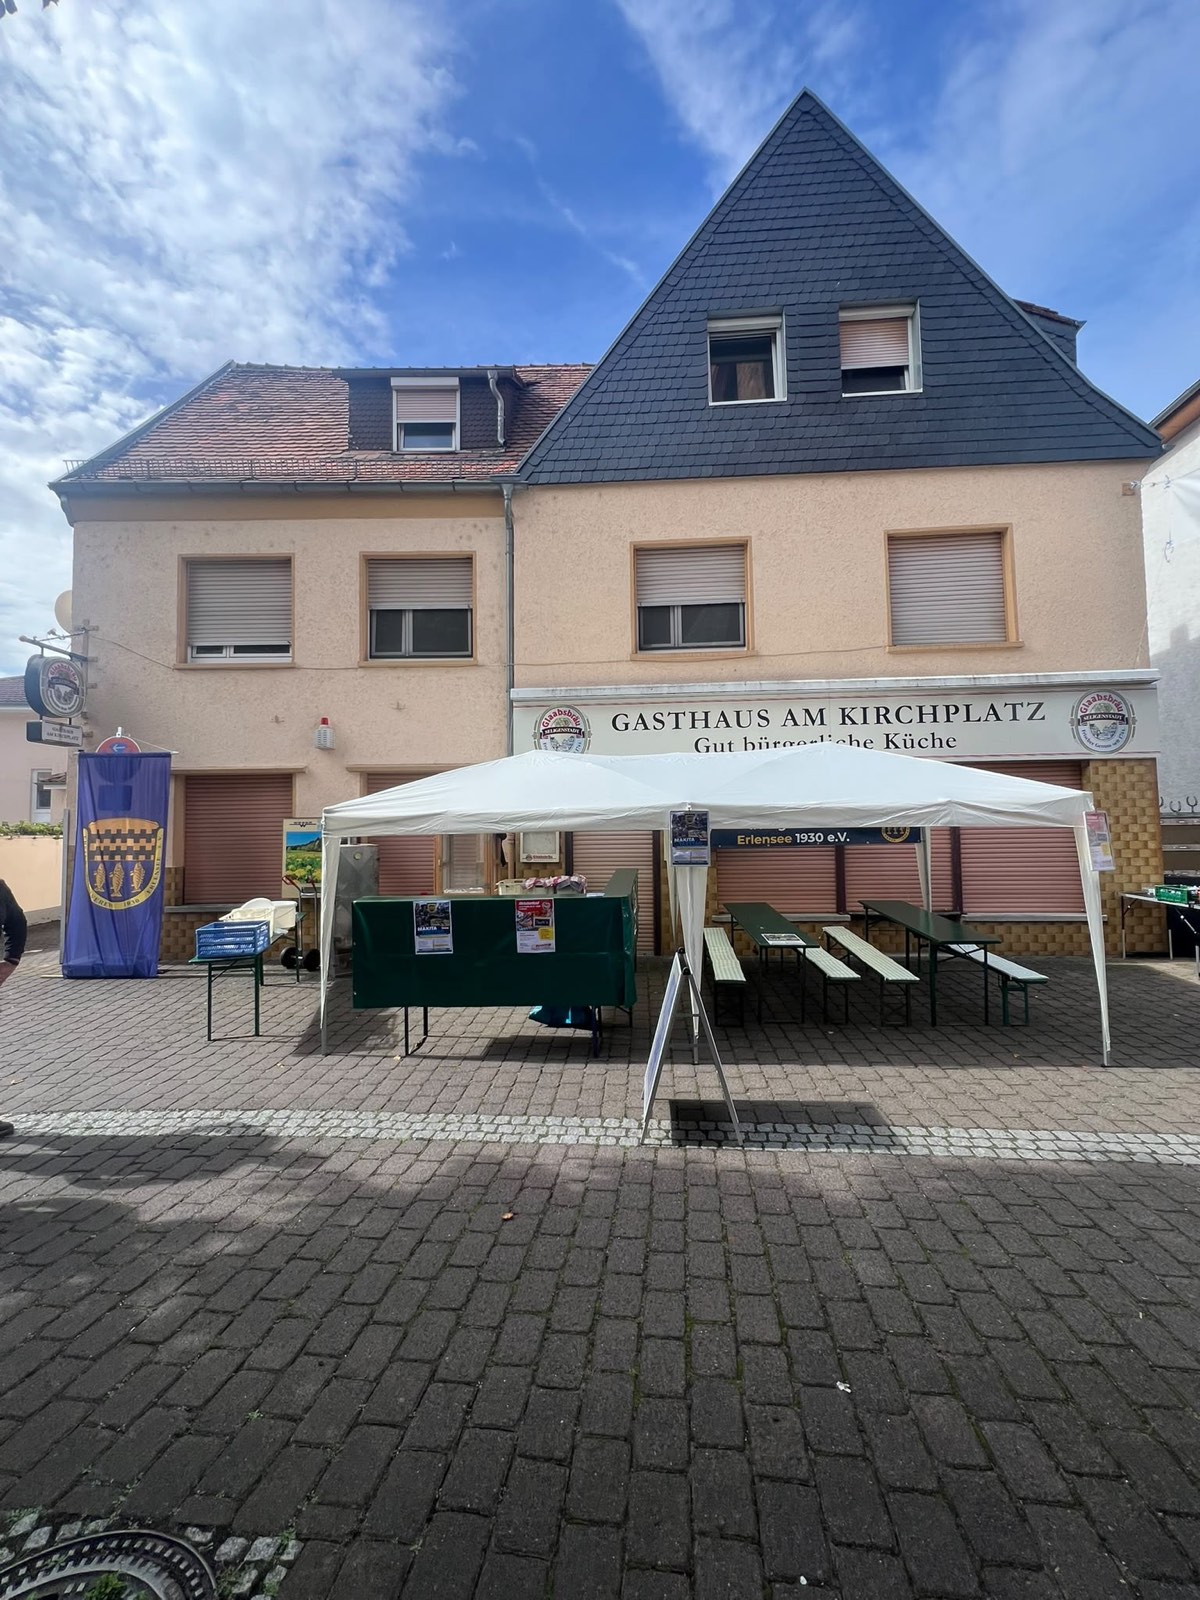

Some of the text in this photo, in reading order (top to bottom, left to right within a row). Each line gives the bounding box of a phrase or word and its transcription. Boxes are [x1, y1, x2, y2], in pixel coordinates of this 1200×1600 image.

[1079, 694, 1124, 714] Glaabsbräu
[541, 708, 581, 728] Glaabsbräu
[611, 701, 1046, 732] GASTHAUS AM KIRCHPLATZ
[694, 736, 735, 753] Gut
[883, 731, 957, 749] Küche
[737, 832, 850, 845] Erlensee 1930 e.V.
